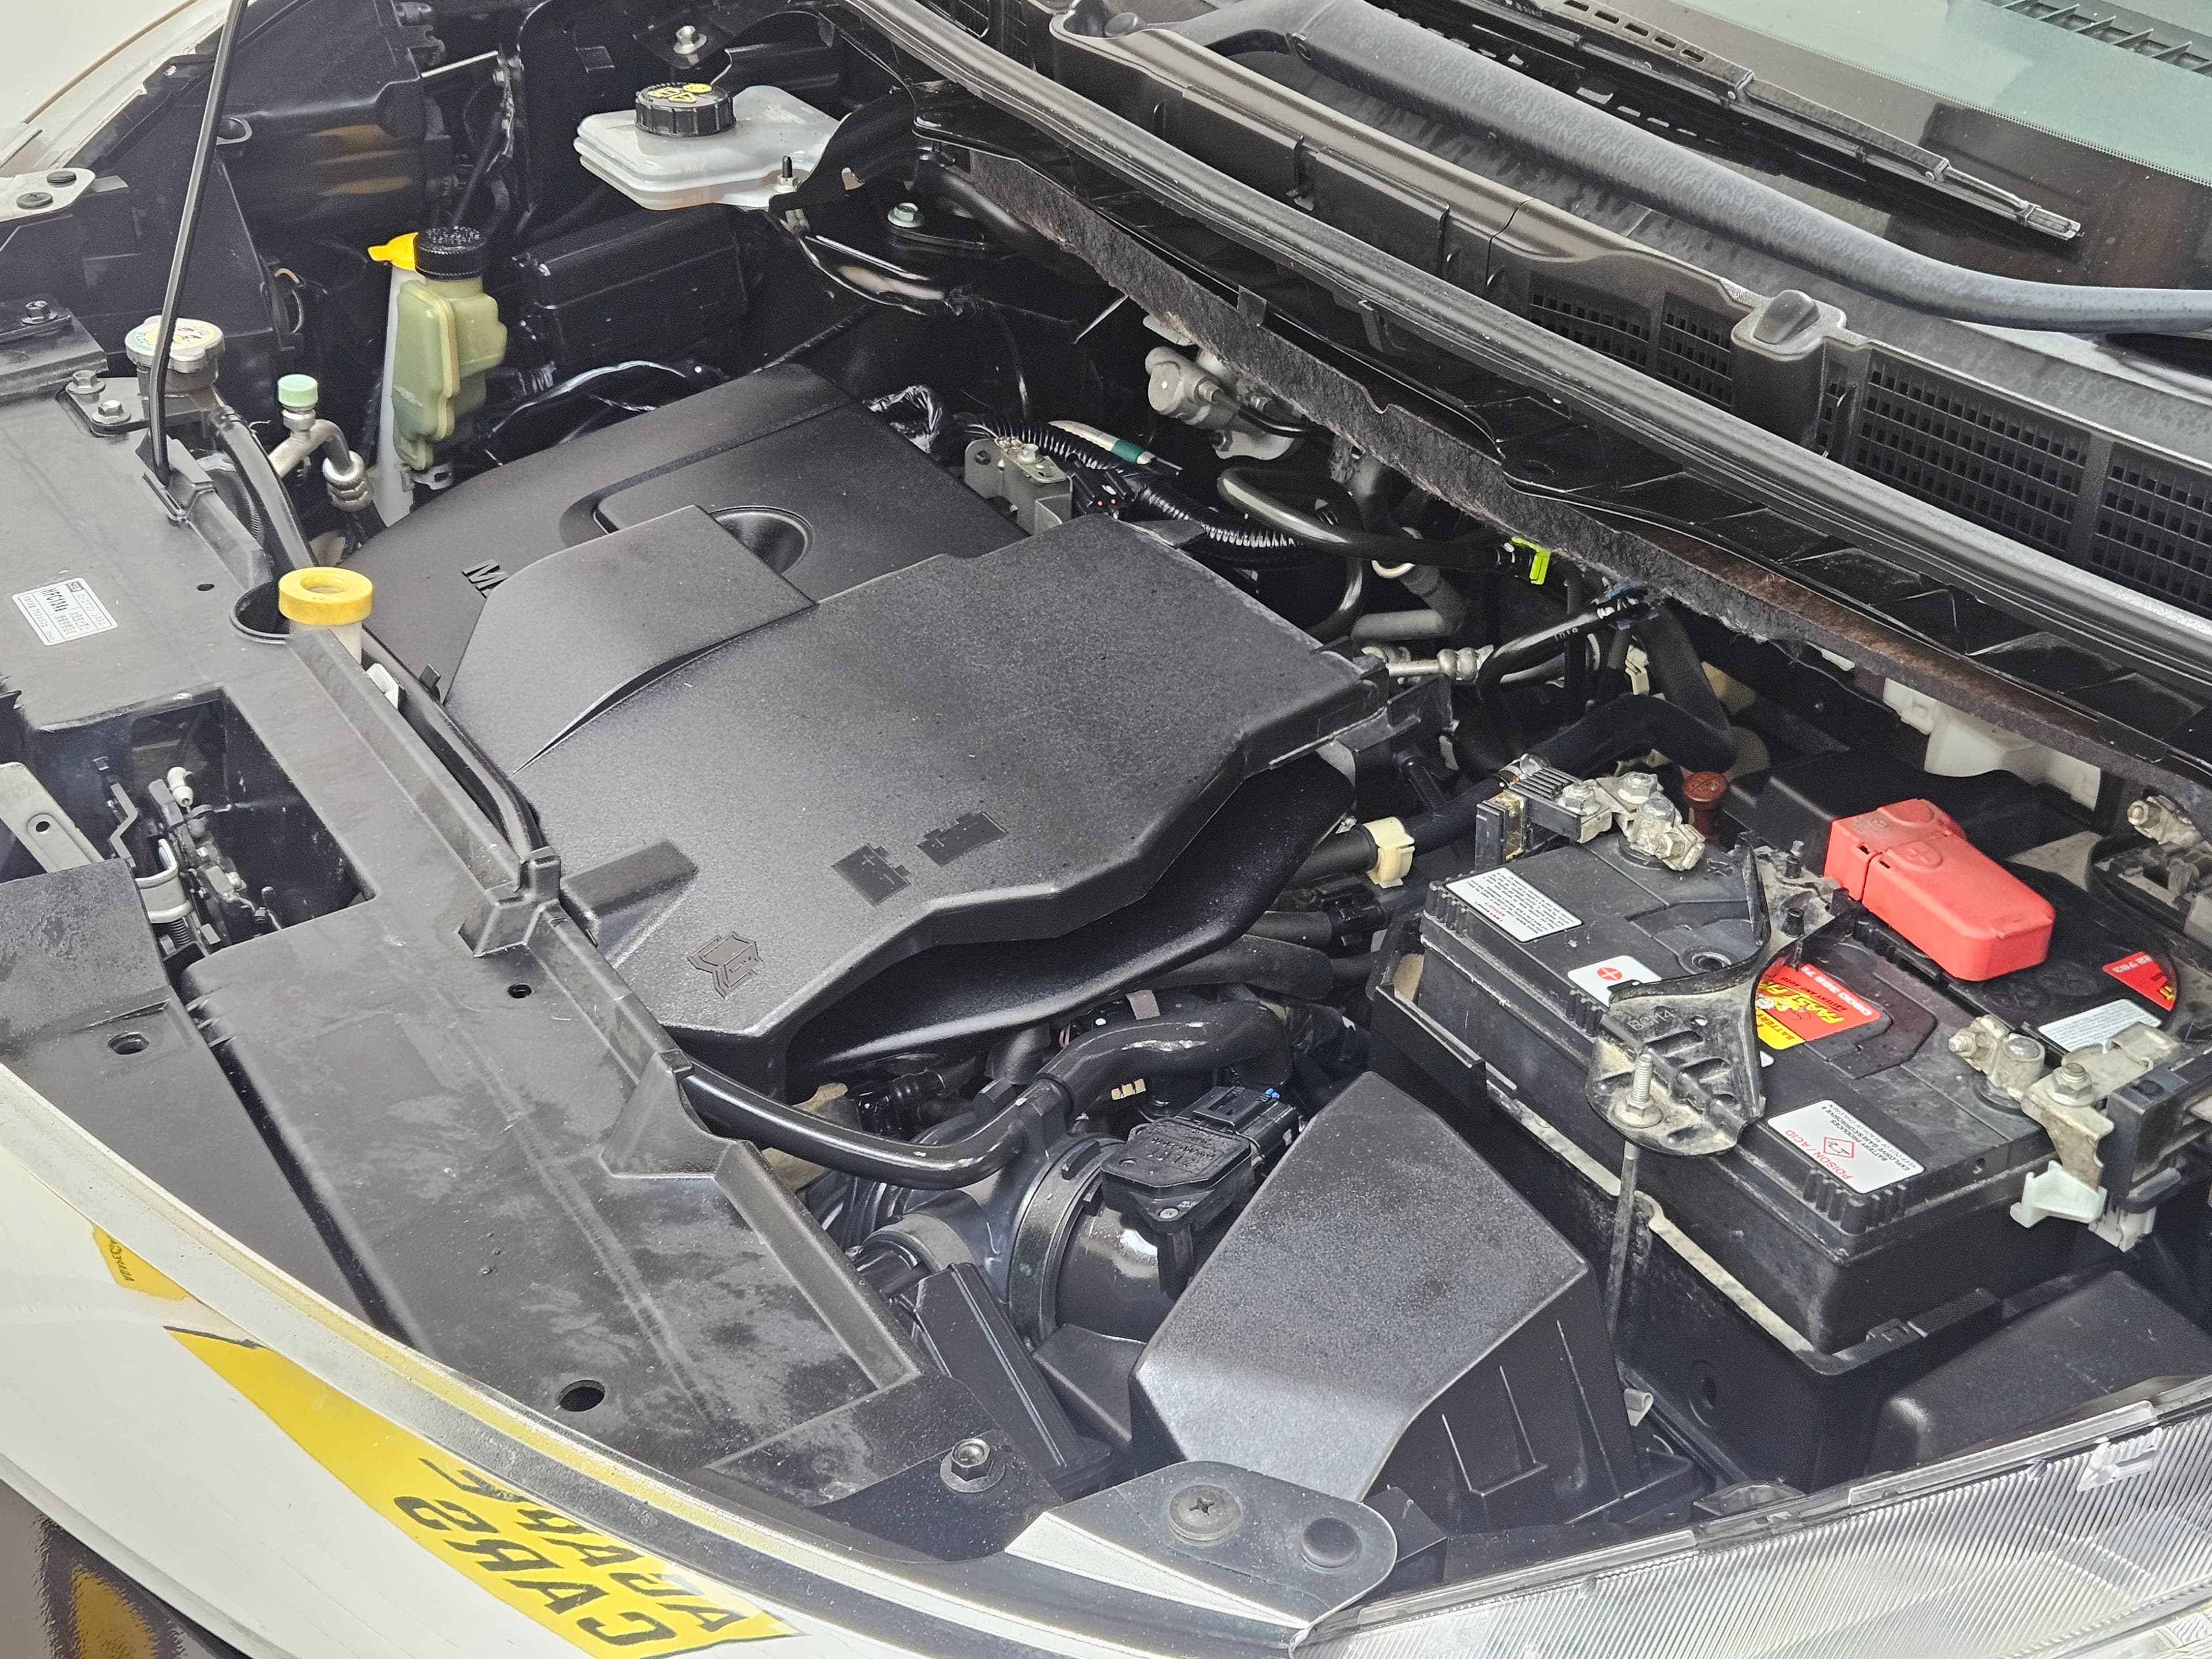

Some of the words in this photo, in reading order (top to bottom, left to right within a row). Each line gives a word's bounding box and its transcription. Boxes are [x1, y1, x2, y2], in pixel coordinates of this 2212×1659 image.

[1780, 976, 1800, 988] AUTO
[1800, 987, 1817, 999] AND
[1817, 994, 1848, 1012] BATTERY
[1786, 993, 1844, 1024] FAAST
[1627, 1009, 1677, 1032] BCM4
[1758, 1013, 1795, 1041] BATTERY
[1828, 1104, 1857, 1124] CHILDREN
[1785, 1130, 1812, 1147] ACID
[1830, 1119, 1863, 1143] PRODUCES
[1861, 1142, 1888, 1162] BATTERY
[1876, 1147, 1911, 1172] EXPLOSIVE
[1815, 1150, 1853, 1180] POISON
